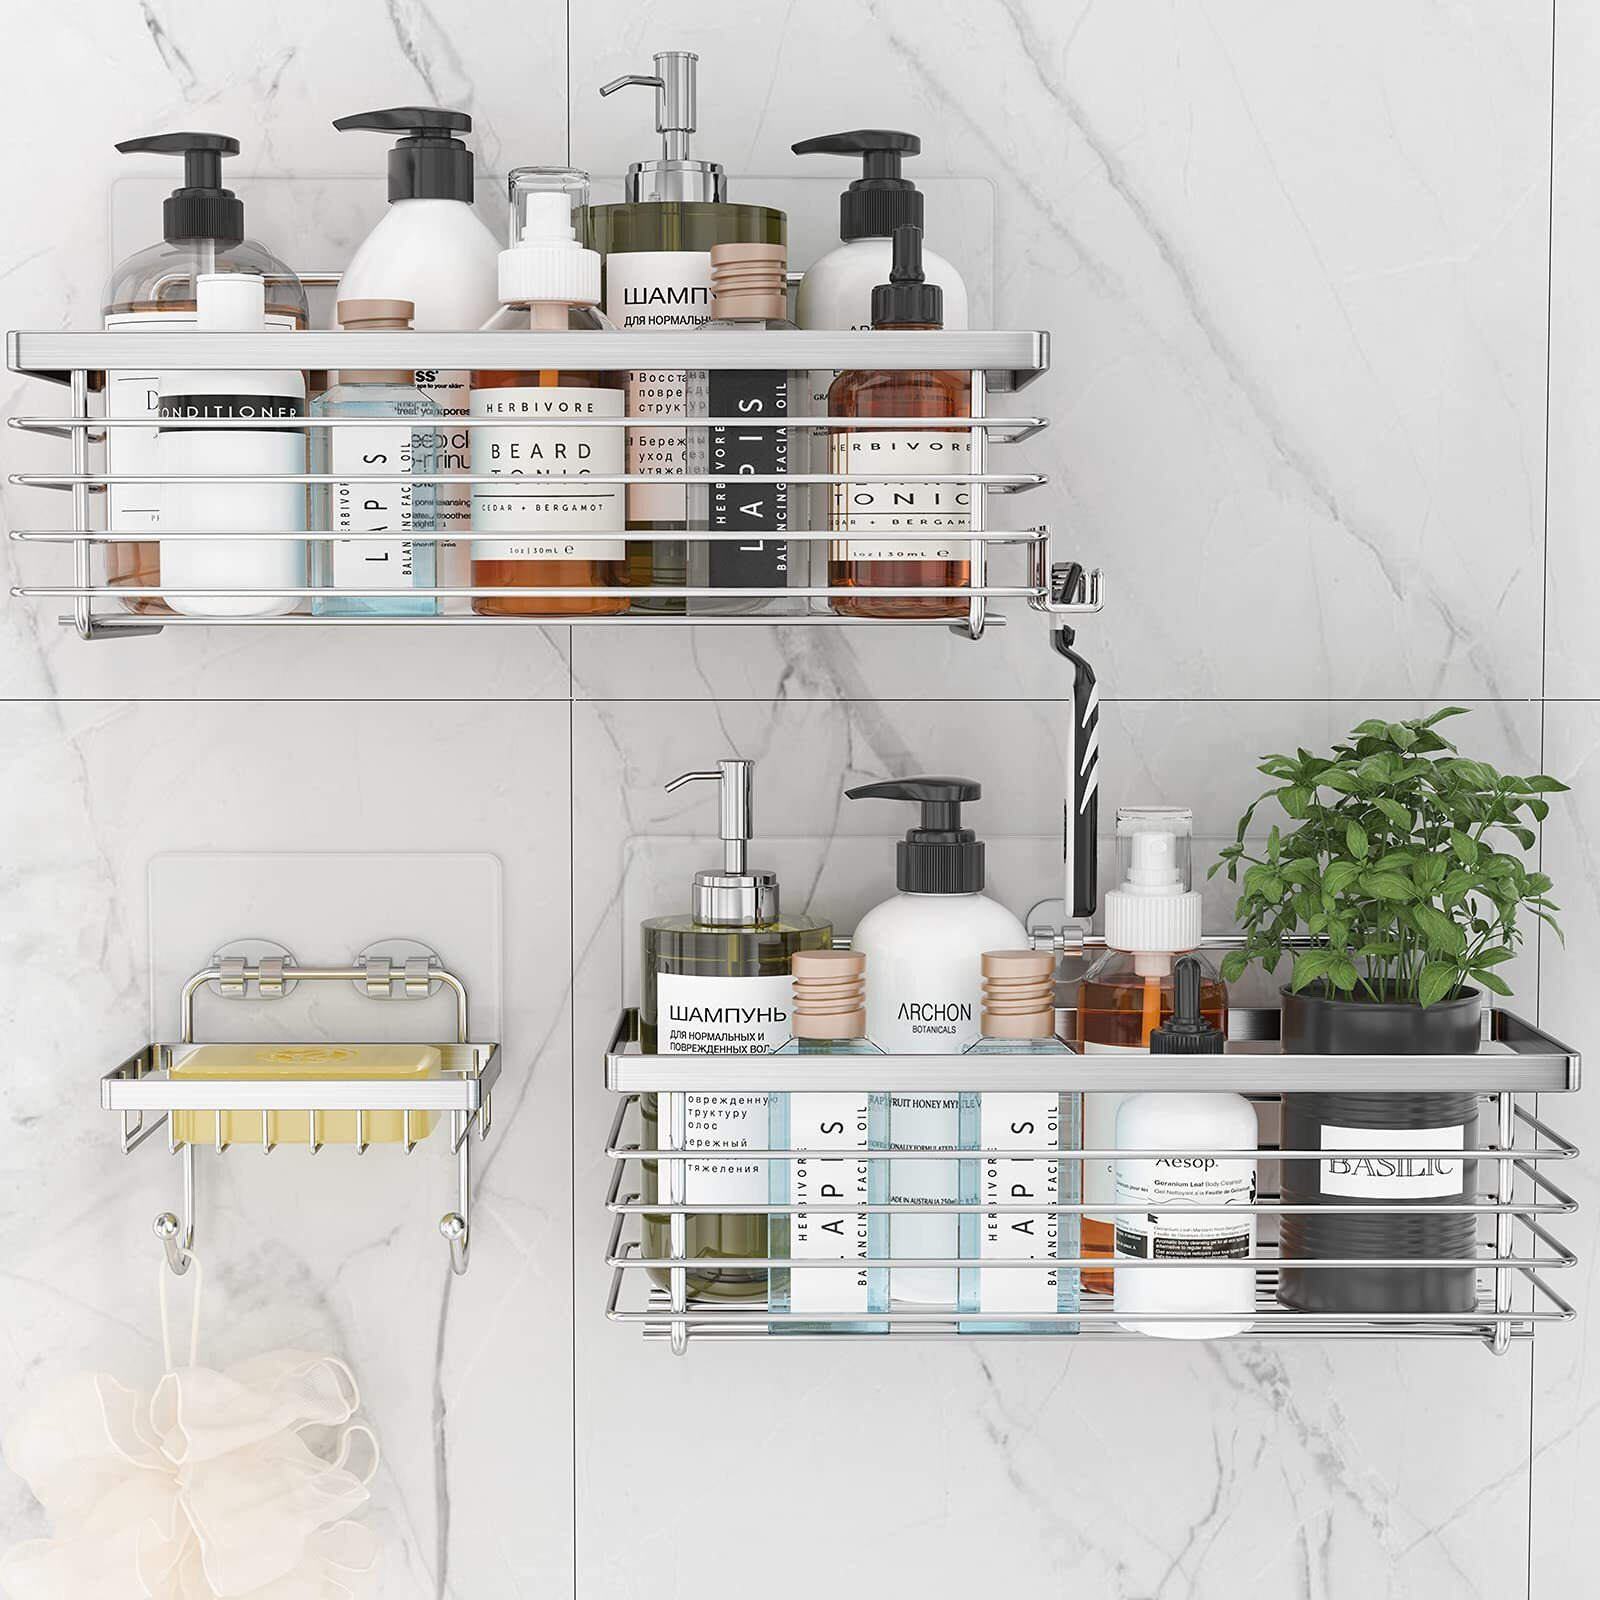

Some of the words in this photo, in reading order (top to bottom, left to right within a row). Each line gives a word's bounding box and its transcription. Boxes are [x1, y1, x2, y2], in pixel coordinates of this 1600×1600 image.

[624, 316, 645, 328] ДЛЯ
[776, 382, 787, 409] OIL
[160, 405, 297, 418] ONDITIONER
[486, 402, 594, 413] HERBIVORE
[401, 443, 411, 462] OIL
[491, 443, 592, 459] BEARD
[776, 427, 787, 473] FACIA
[639, 453, 673, 463] уход
[715, 426, 727, 525] HERBVORE
[834, 493, 969, 505] TONIC
[481, 504, 513, 512] CEDAR
[535, 503, 604, 512] BERGAMOT
[776, 482, 787, 571] BALNCING
[401, 512, 412, 576] BALANING
[669, 1004, 788, 1024] ШАМПУНЬ
[897, 1002, 972, 1022] ARCHON
[669, 1029, 687, 1040] ДЛЯ
[688, 1032, 756, 1042] НОРМАЛЬНЫХ
[757, 1032, 765, 1041] И
[911, 1025, 957, 1034] BOTANICALS
[670, 1041, 748, 1055] ПОВРЕЖДЕННЫХ
[750, 1044, 771, 1054] ВОЛ
[912, 1099, 942, 1109] HONEY
[687, 1108, 748, 1120] труктуру
[857, 1106, 868, 1131] OIL
[1047, 1106, 1058, 1131] OIL
[687, 1121, 718, 1131] олос
[687, 1138, 748, 1149] ережный
[687, 1163, 760, 1174] тяжеления
[857, 1139, 868, 1192] FACIL
[1047, 1139, 1058, 1192] FACIL
[1328, 1153, 1454, 1177] BASILIC
[820, 1121, 845, 1260] APIS
[1010, 1121, 1035, 1260] APIS
[1154, 1179, 1189, 1188] Geranium
[910, 1197, 940, 1205] AUSTRALIA
